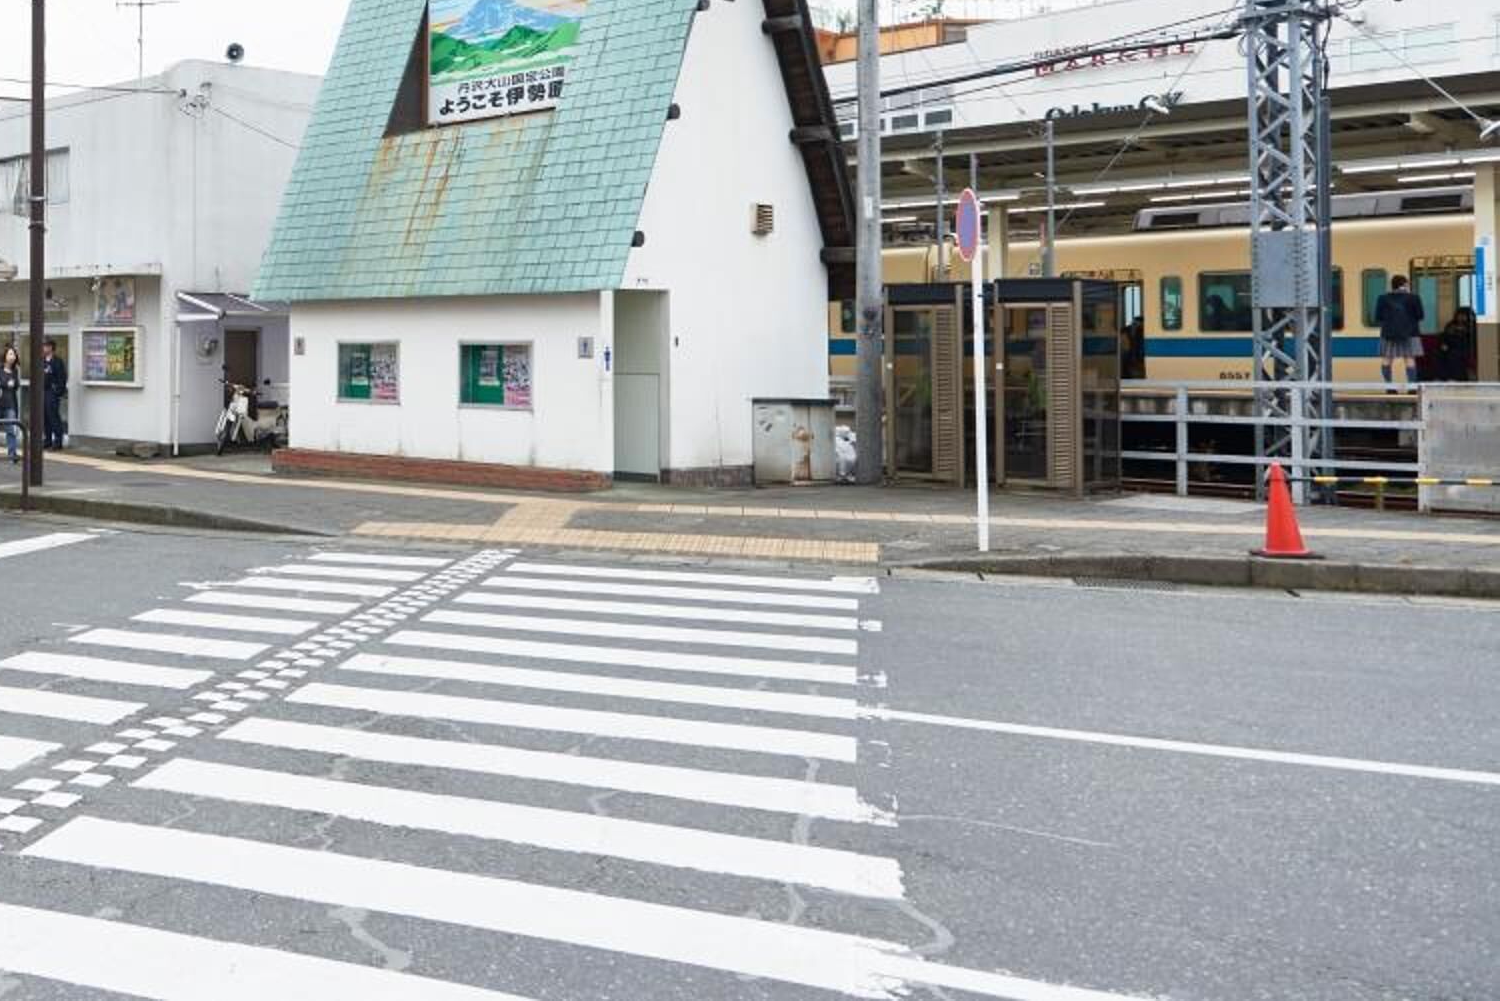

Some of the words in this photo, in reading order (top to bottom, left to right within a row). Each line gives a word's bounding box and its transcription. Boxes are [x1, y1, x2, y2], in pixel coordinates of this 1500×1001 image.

[440, 80, 563, 115] ようこそ伊勢原
